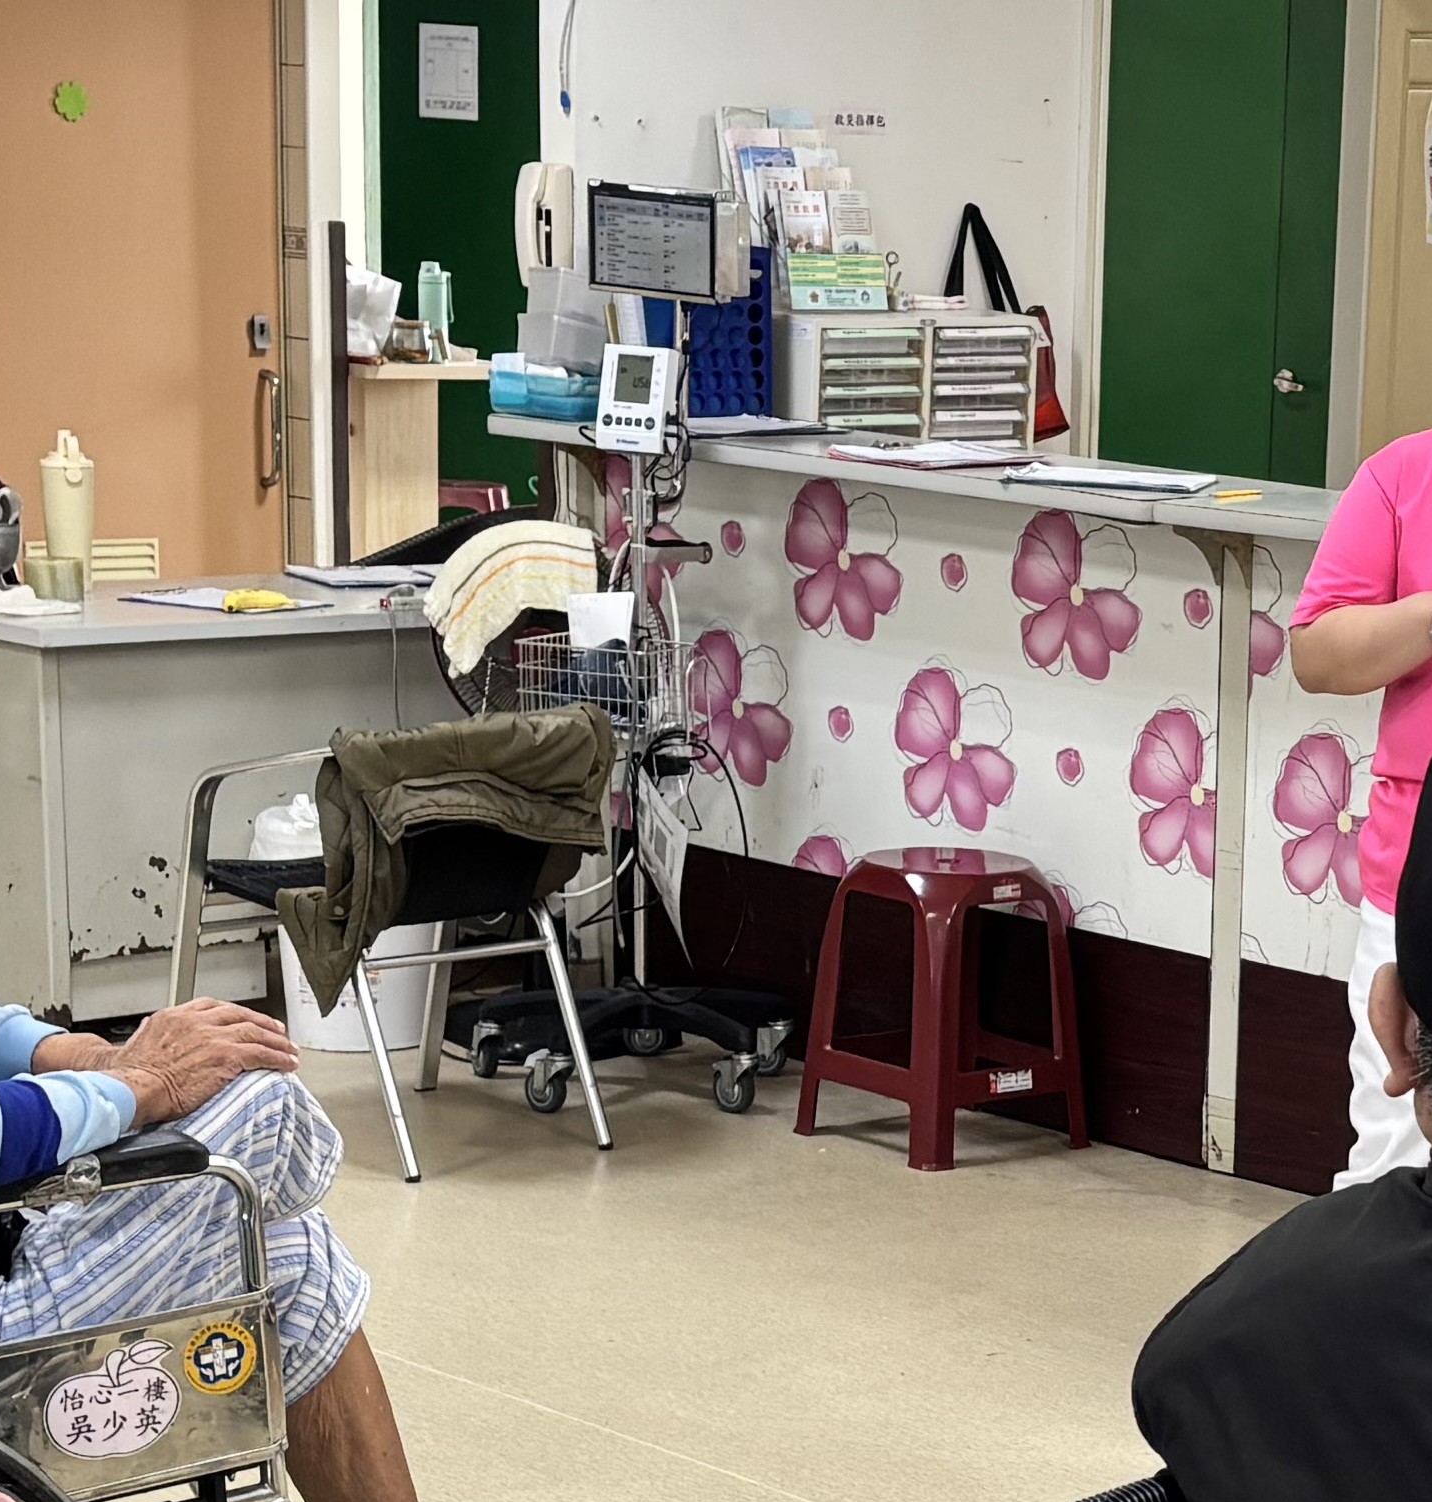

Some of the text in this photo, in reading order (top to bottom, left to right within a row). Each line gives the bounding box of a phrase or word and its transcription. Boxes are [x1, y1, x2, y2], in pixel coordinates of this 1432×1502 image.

[59, 1376, 169, 1414] 怡心一樓
[66, 1404, 163, 1446] 吳少英
